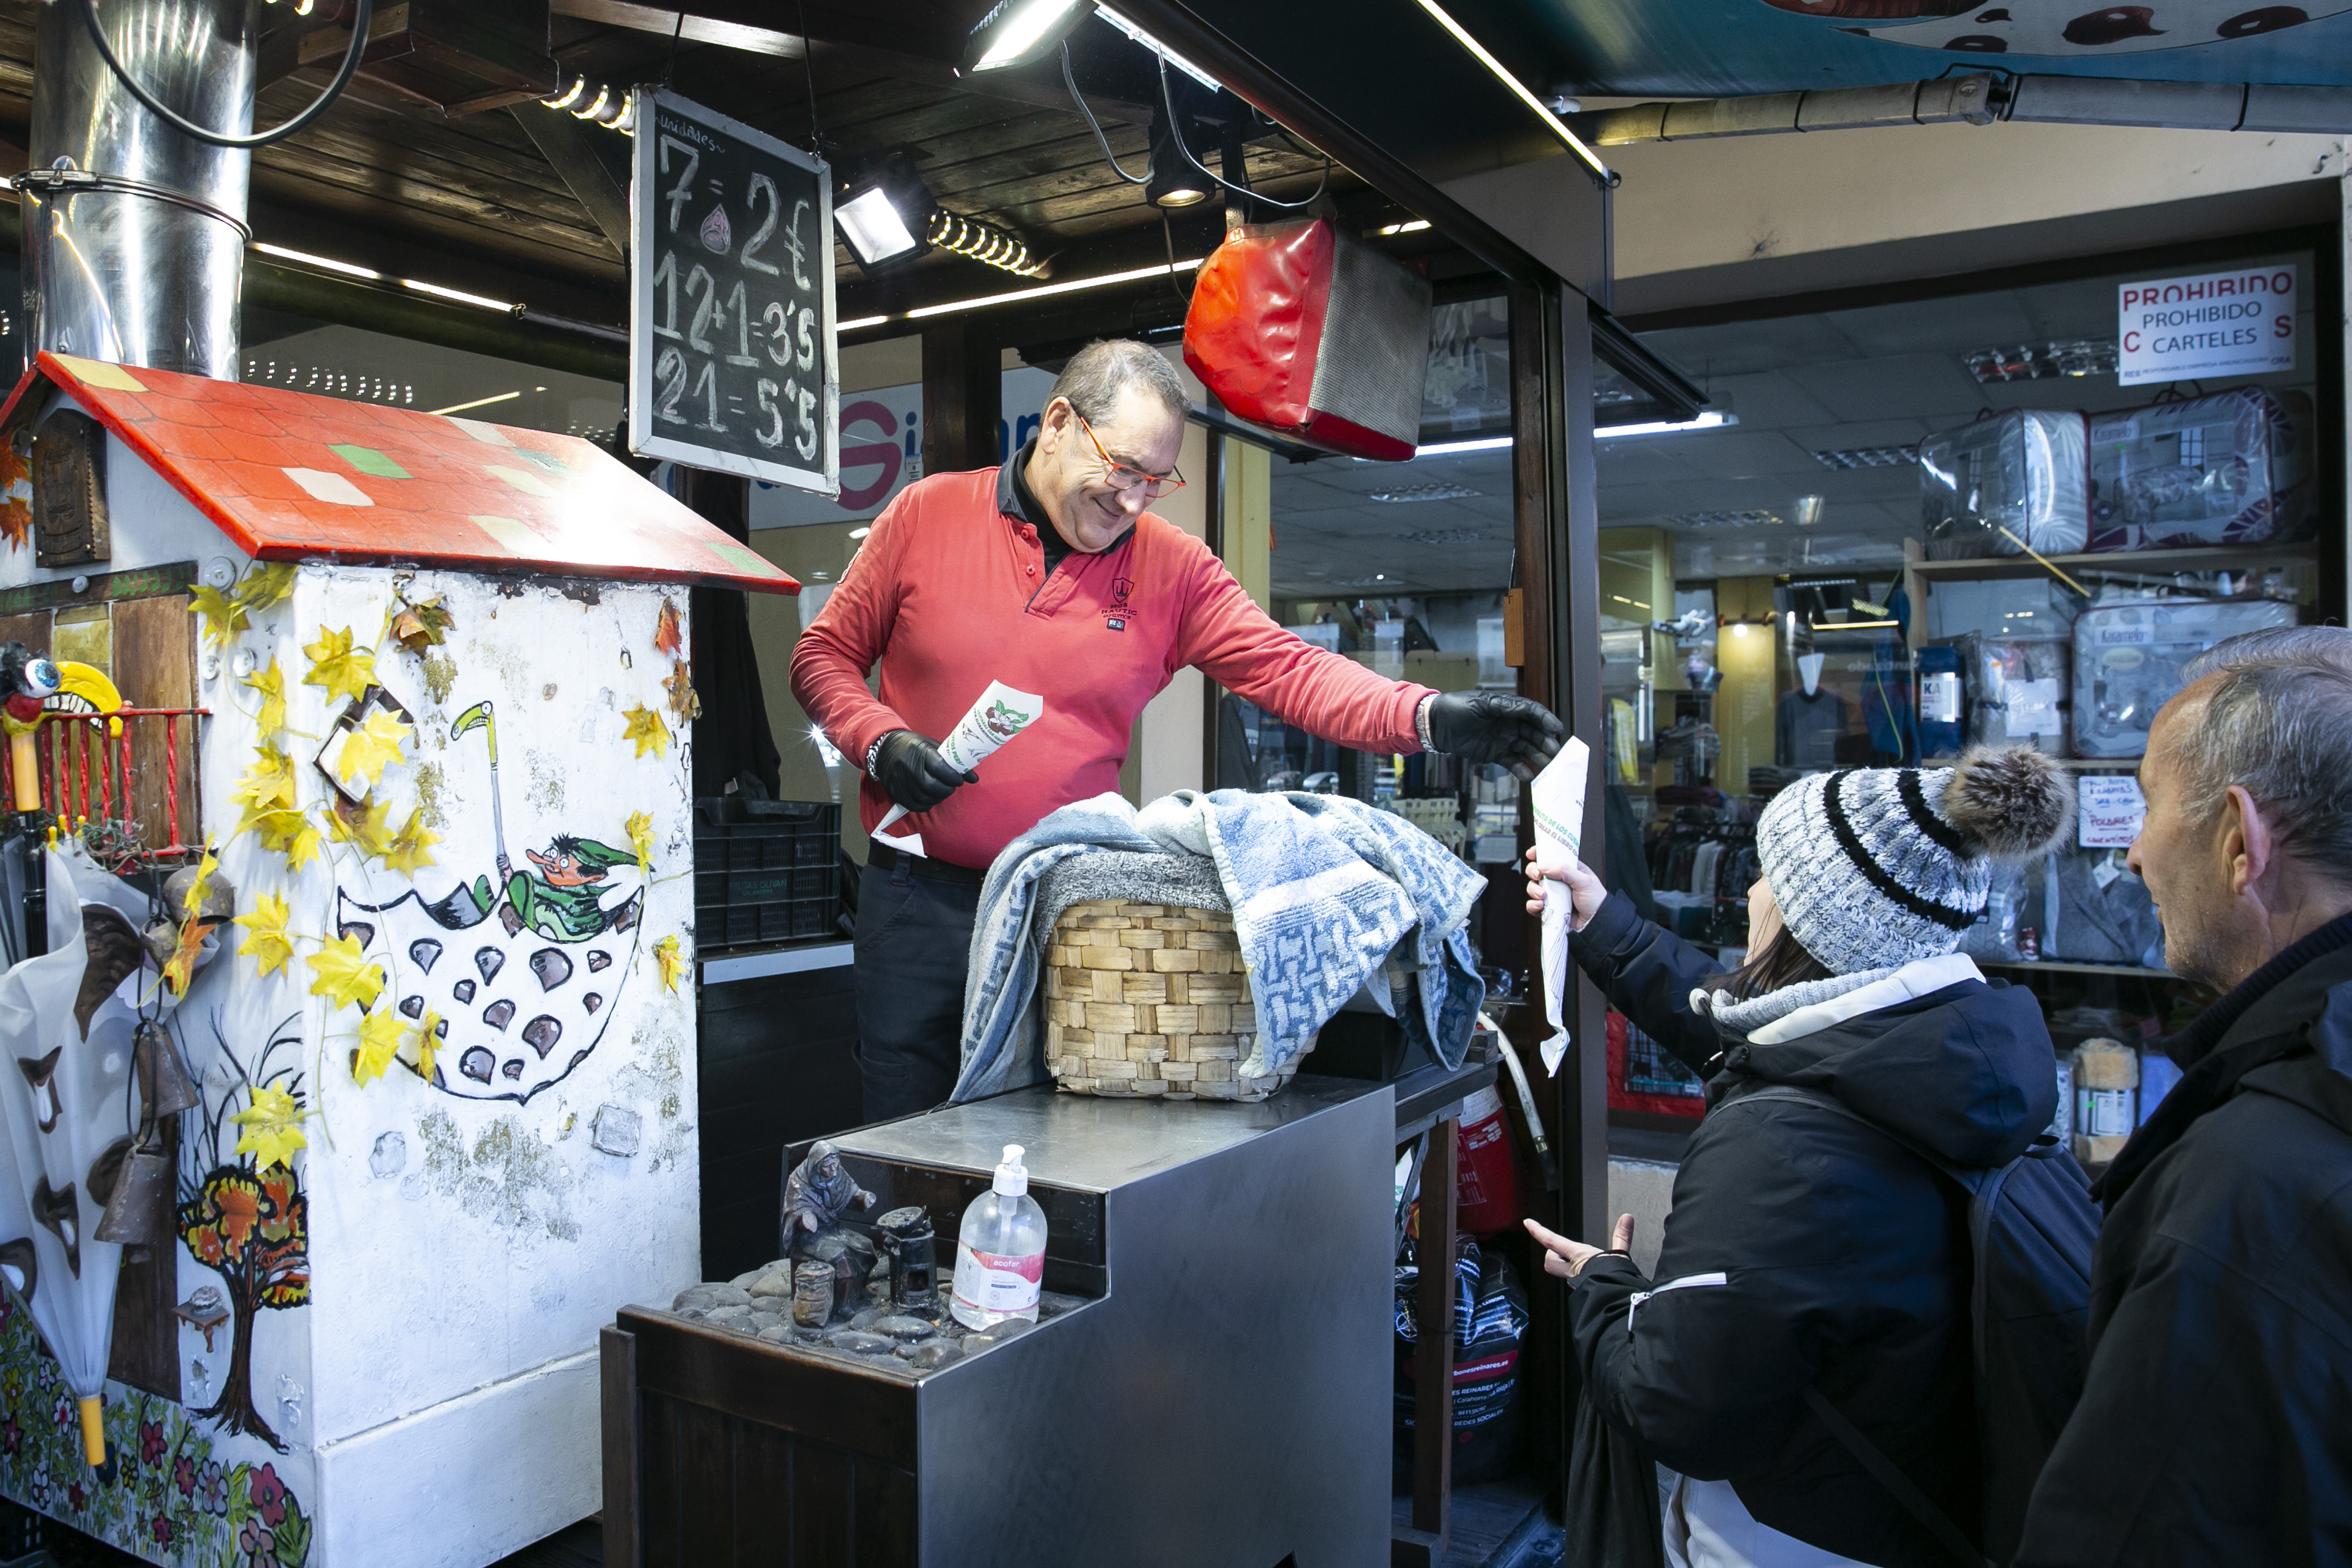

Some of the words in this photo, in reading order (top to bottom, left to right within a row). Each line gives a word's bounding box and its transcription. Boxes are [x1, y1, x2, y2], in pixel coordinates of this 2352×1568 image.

[2143, 301, 2262, 329] PROHIBIDO
[2152, 328, 2257, 354] CARTELES
[1557, 835, 1573, 851] LIBRO
[1461, 1383, 1494, 1395] REINARES
[1476, 1408, 1504, 1423] SOCIALES
